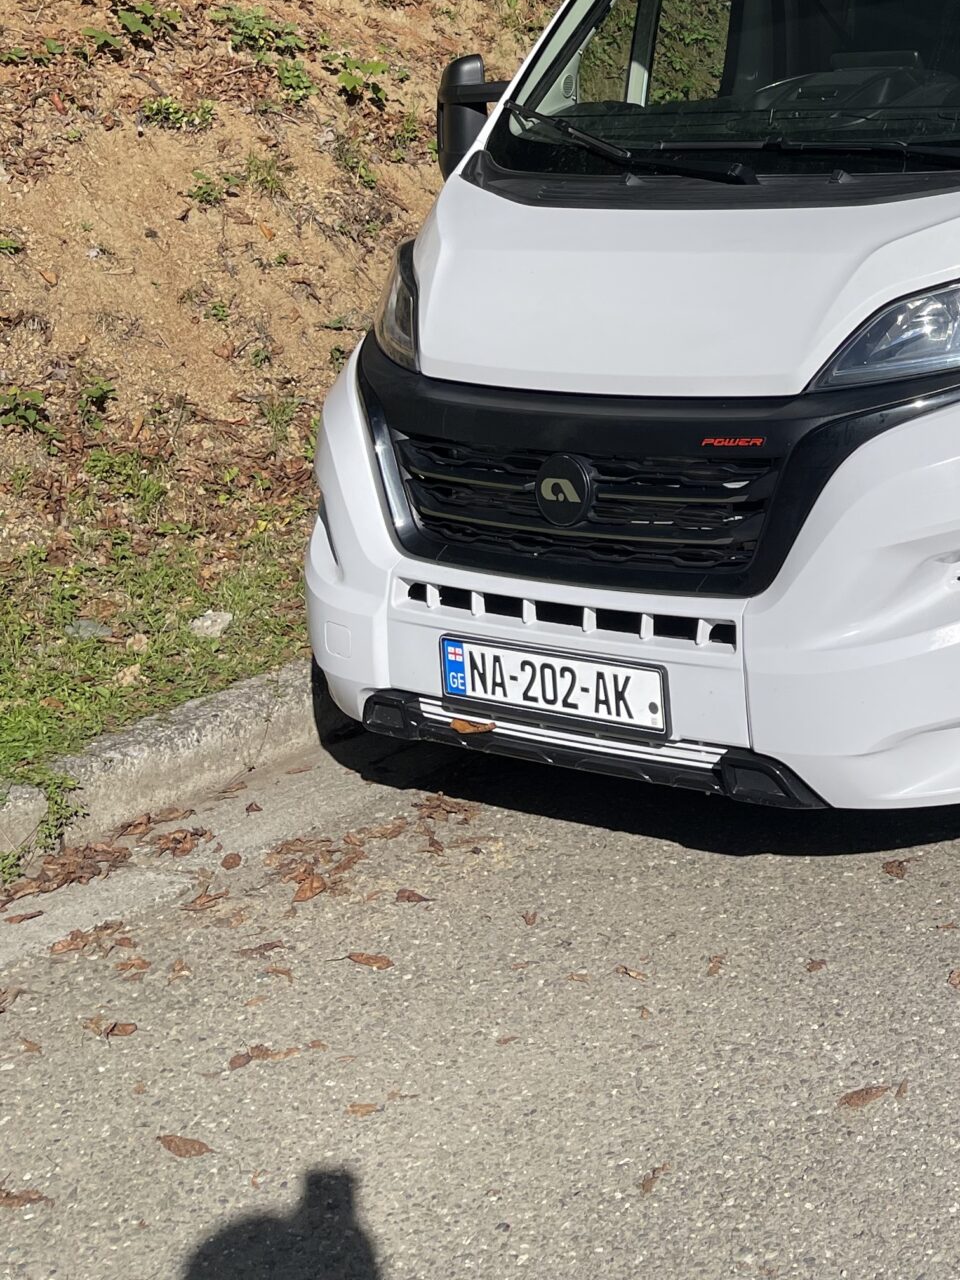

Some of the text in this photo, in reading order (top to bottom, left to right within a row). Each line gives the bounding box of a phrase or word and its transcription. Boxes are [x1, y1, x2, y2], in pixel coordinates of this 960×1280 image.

[701, 438, 764, 447] POWER
[449, 672, 465, 690] GE
[468, 650, 634, 720] NA-202-AK
